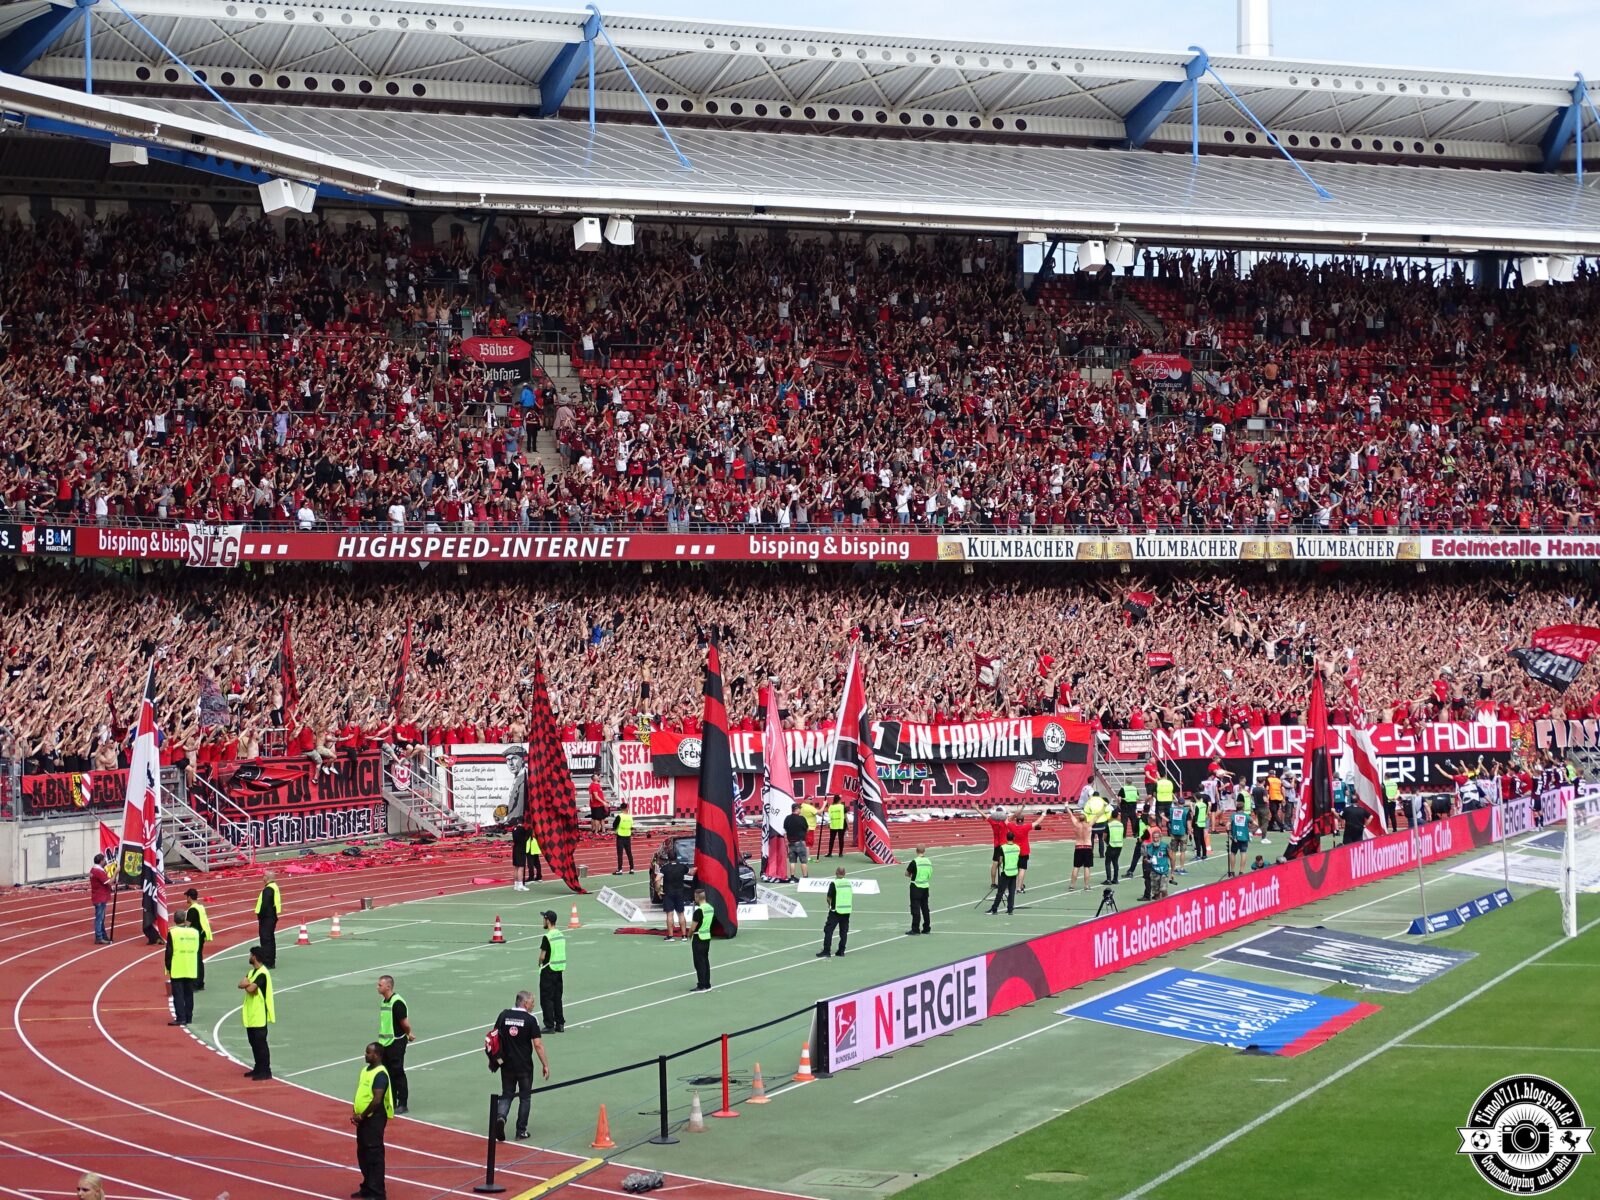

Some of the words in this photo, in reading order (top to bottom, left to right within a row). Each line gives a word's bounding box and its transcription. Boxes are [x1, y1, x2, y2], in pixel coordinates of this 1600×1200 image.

[479, 342, 514, 357] Böhse
[46, 528, 71, 546] B&M
[99, 530, 148, 555] bisping
[151, 532, 160, 551] &
[162, 532, 188, 557] bisp
[337, 536, 630, 558] HIGHSPEED-INTERNET
[749, 535, 820, 560] bisping
[823, 536, 838, 555] &
[841, 536, 910, 560] bisping
[967, 537, 1075, 558] KULMBACHER
[1135, 537, 1238, 558] KULMBACHER
[1296, 537, 1395, 557] KULMBACHER
[1432, 538, 1541, 557] Edelmetalle
[189, 535, 239, 567] SIEG
[908, 724, 934, 760] IN
[939, 719, 1033, 760] FRANKEN
[567, 755, 597, 770] IVALITÄT
[267, 812, 304, 846] FÜR
[305, 807, 371, 841] ULTRAS!
[1350, 837, 1409, 879] Willkommen
[1411, 826, 1433, 861] beim
[1434, 821, 1452, 853] Club
[1094, 927, 1119, 969] Mit
[1122, 899, 1202, 958] Leidenschaft
[1204, 897, 1216, 929] in
[1218, 890, 1236, 924] die
[1238, 875, 1280, 918] Zukunft
[835, 1050, 858, 1065] BUNDESLIGA
